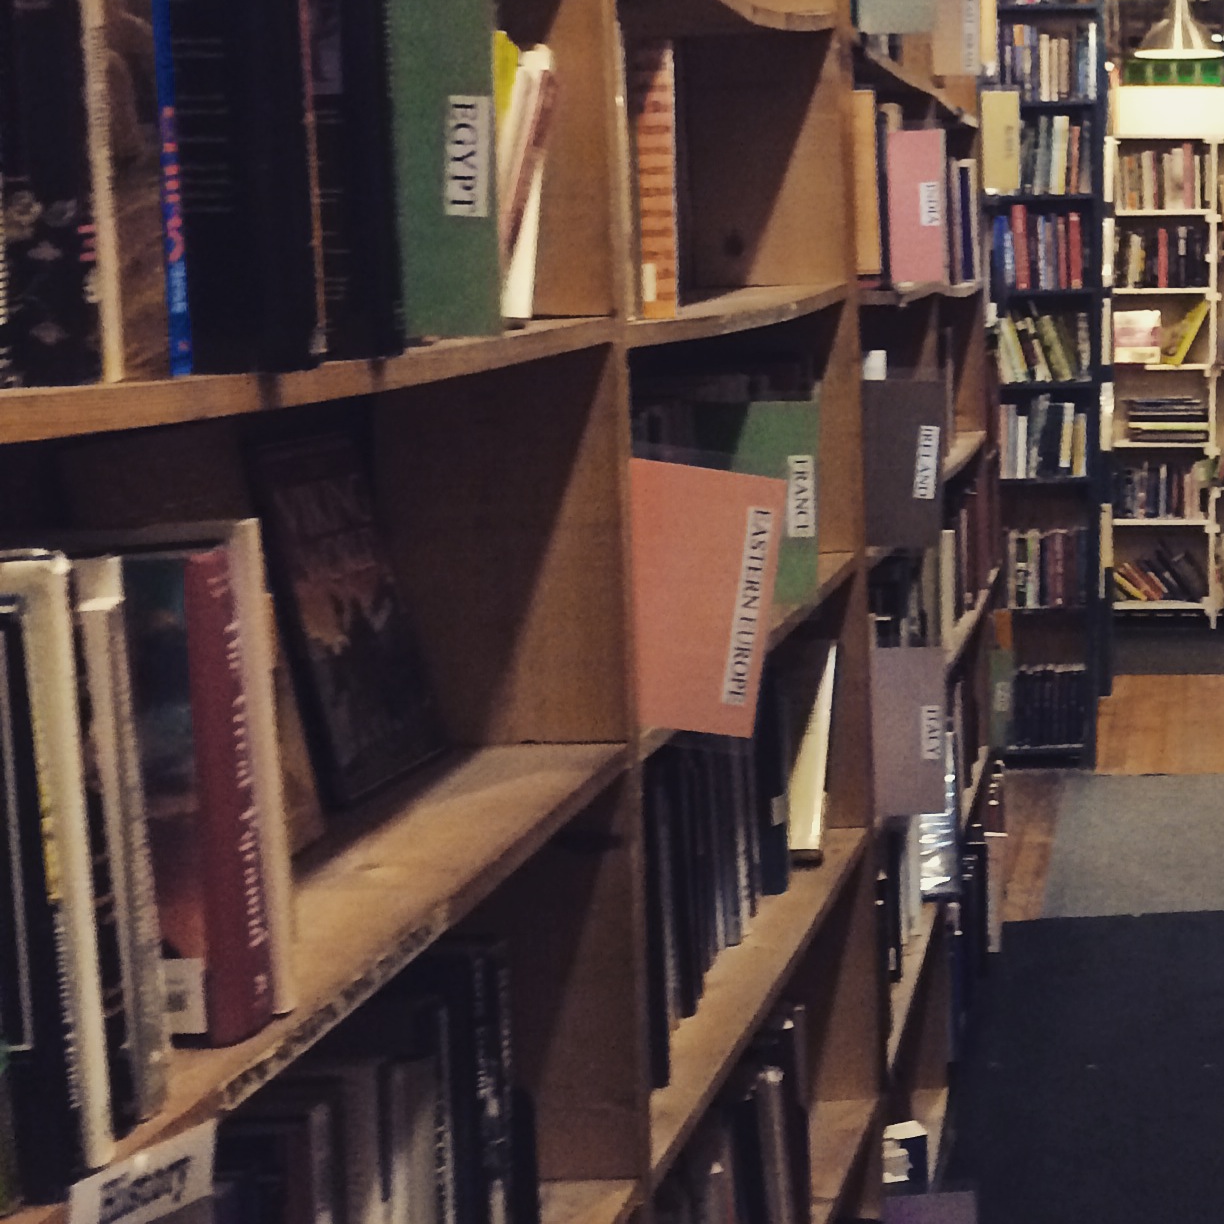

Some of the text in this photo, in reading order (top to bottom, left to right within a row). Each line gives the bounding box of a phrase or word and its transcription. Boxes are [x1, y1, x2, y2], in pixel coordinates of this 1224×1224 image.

[450, 103, 477, 213] EGYPT
[794, 459, 810, 534] FRANCE
[918, 428, 933, 497] IRELAND
[728, 509, 772, 702] EASTERN EUROPE
[926, 709, 941, 756] ITALY
